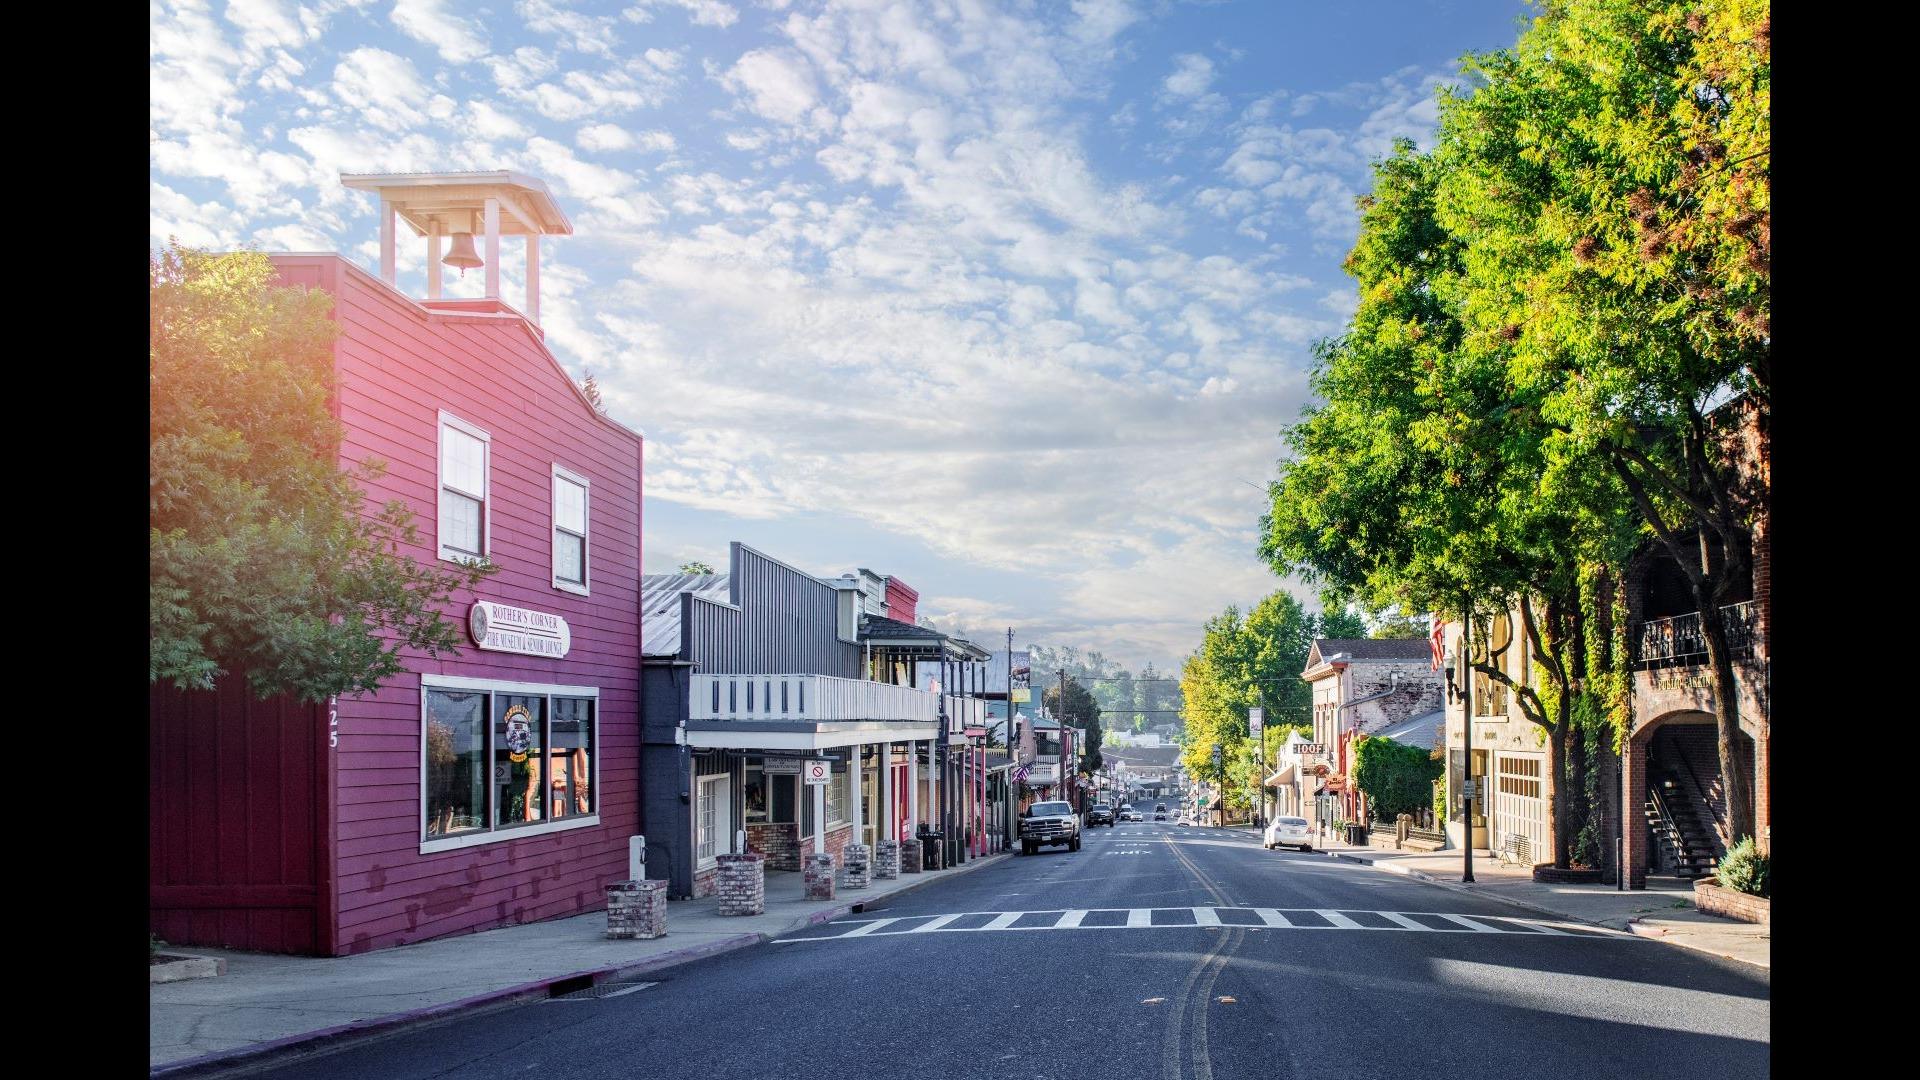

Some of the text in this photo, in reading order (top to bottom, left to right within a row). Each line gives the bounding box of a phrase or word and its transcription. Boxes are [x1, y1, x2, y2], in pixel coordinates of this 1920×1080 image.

[492, 606, 558, 629] ROTHER'S CORNER
[487, 632, 500, 647] FIRE
[500, 633, 522, 650] MUSEUM
[527, 637, 544, 653] SENIOR
[545, 640, 562, 655] LOUNGE
[1658, 678, 1683, 690] PUBLIC
[1297, 744, 1322, 753] IOOF
